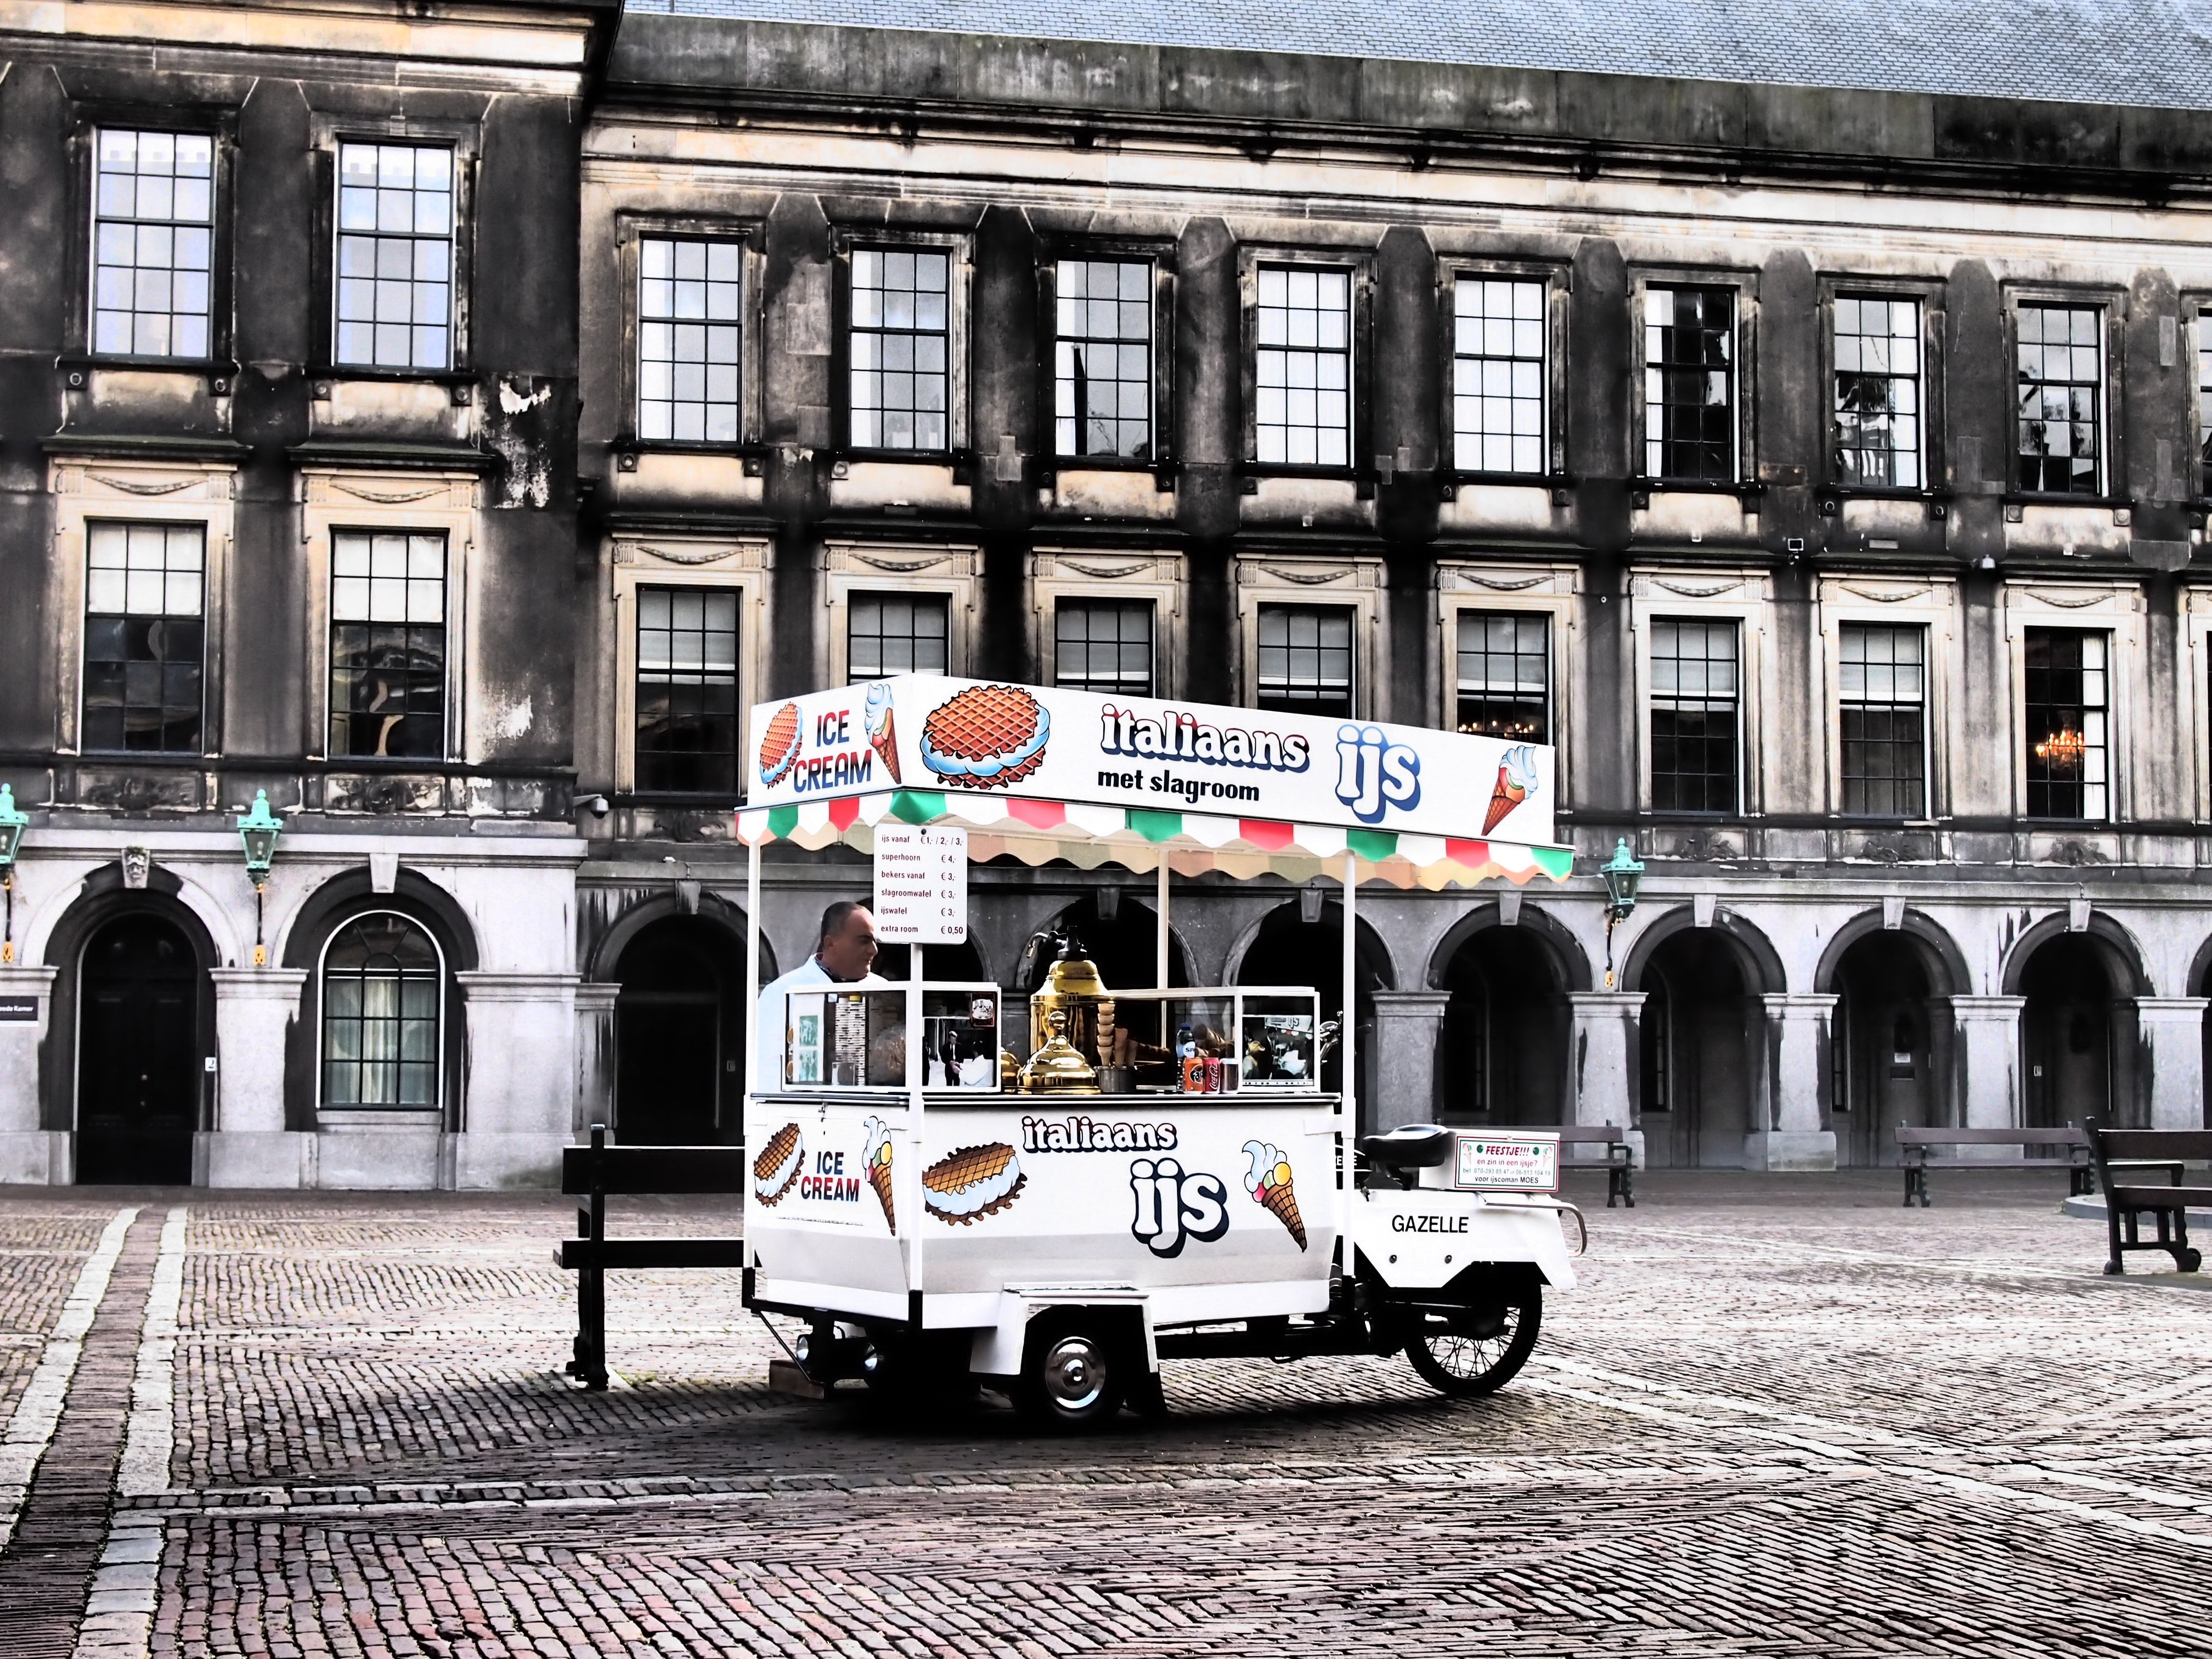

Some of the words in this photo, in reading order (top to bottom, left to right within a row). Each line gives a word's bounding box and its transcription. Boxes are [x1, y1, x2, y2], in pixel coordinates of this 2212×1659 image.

[816, 709, 850, 747] ICE
[1101, 703, 1310, 774] italiaans
[794, 749, 872, 793] CREAM
[1335, 724, 1421, 824] ijs
[1098, 769, 1143, 790] met
[1149, 770, 1260, 804] slagroom
[881, 889, 932, 898] slagroomwafel
[881, 906, 907, 915] ijswafel
[947, 926, 963, 935] 0,50
[208, 1059, 215, 1069] 2
[1022, 1116, 1177, 1153] italiaans
[816, 1151, 844, 1175] ICE
[1486, 1146, 1530, 1156] FEESTJE!!!
[801, 1176, 860, 1201] CREAM
[1130, 1158, 1229, 1259] ijs
[1392, 1215, 1469, 1233] GAZELLE
